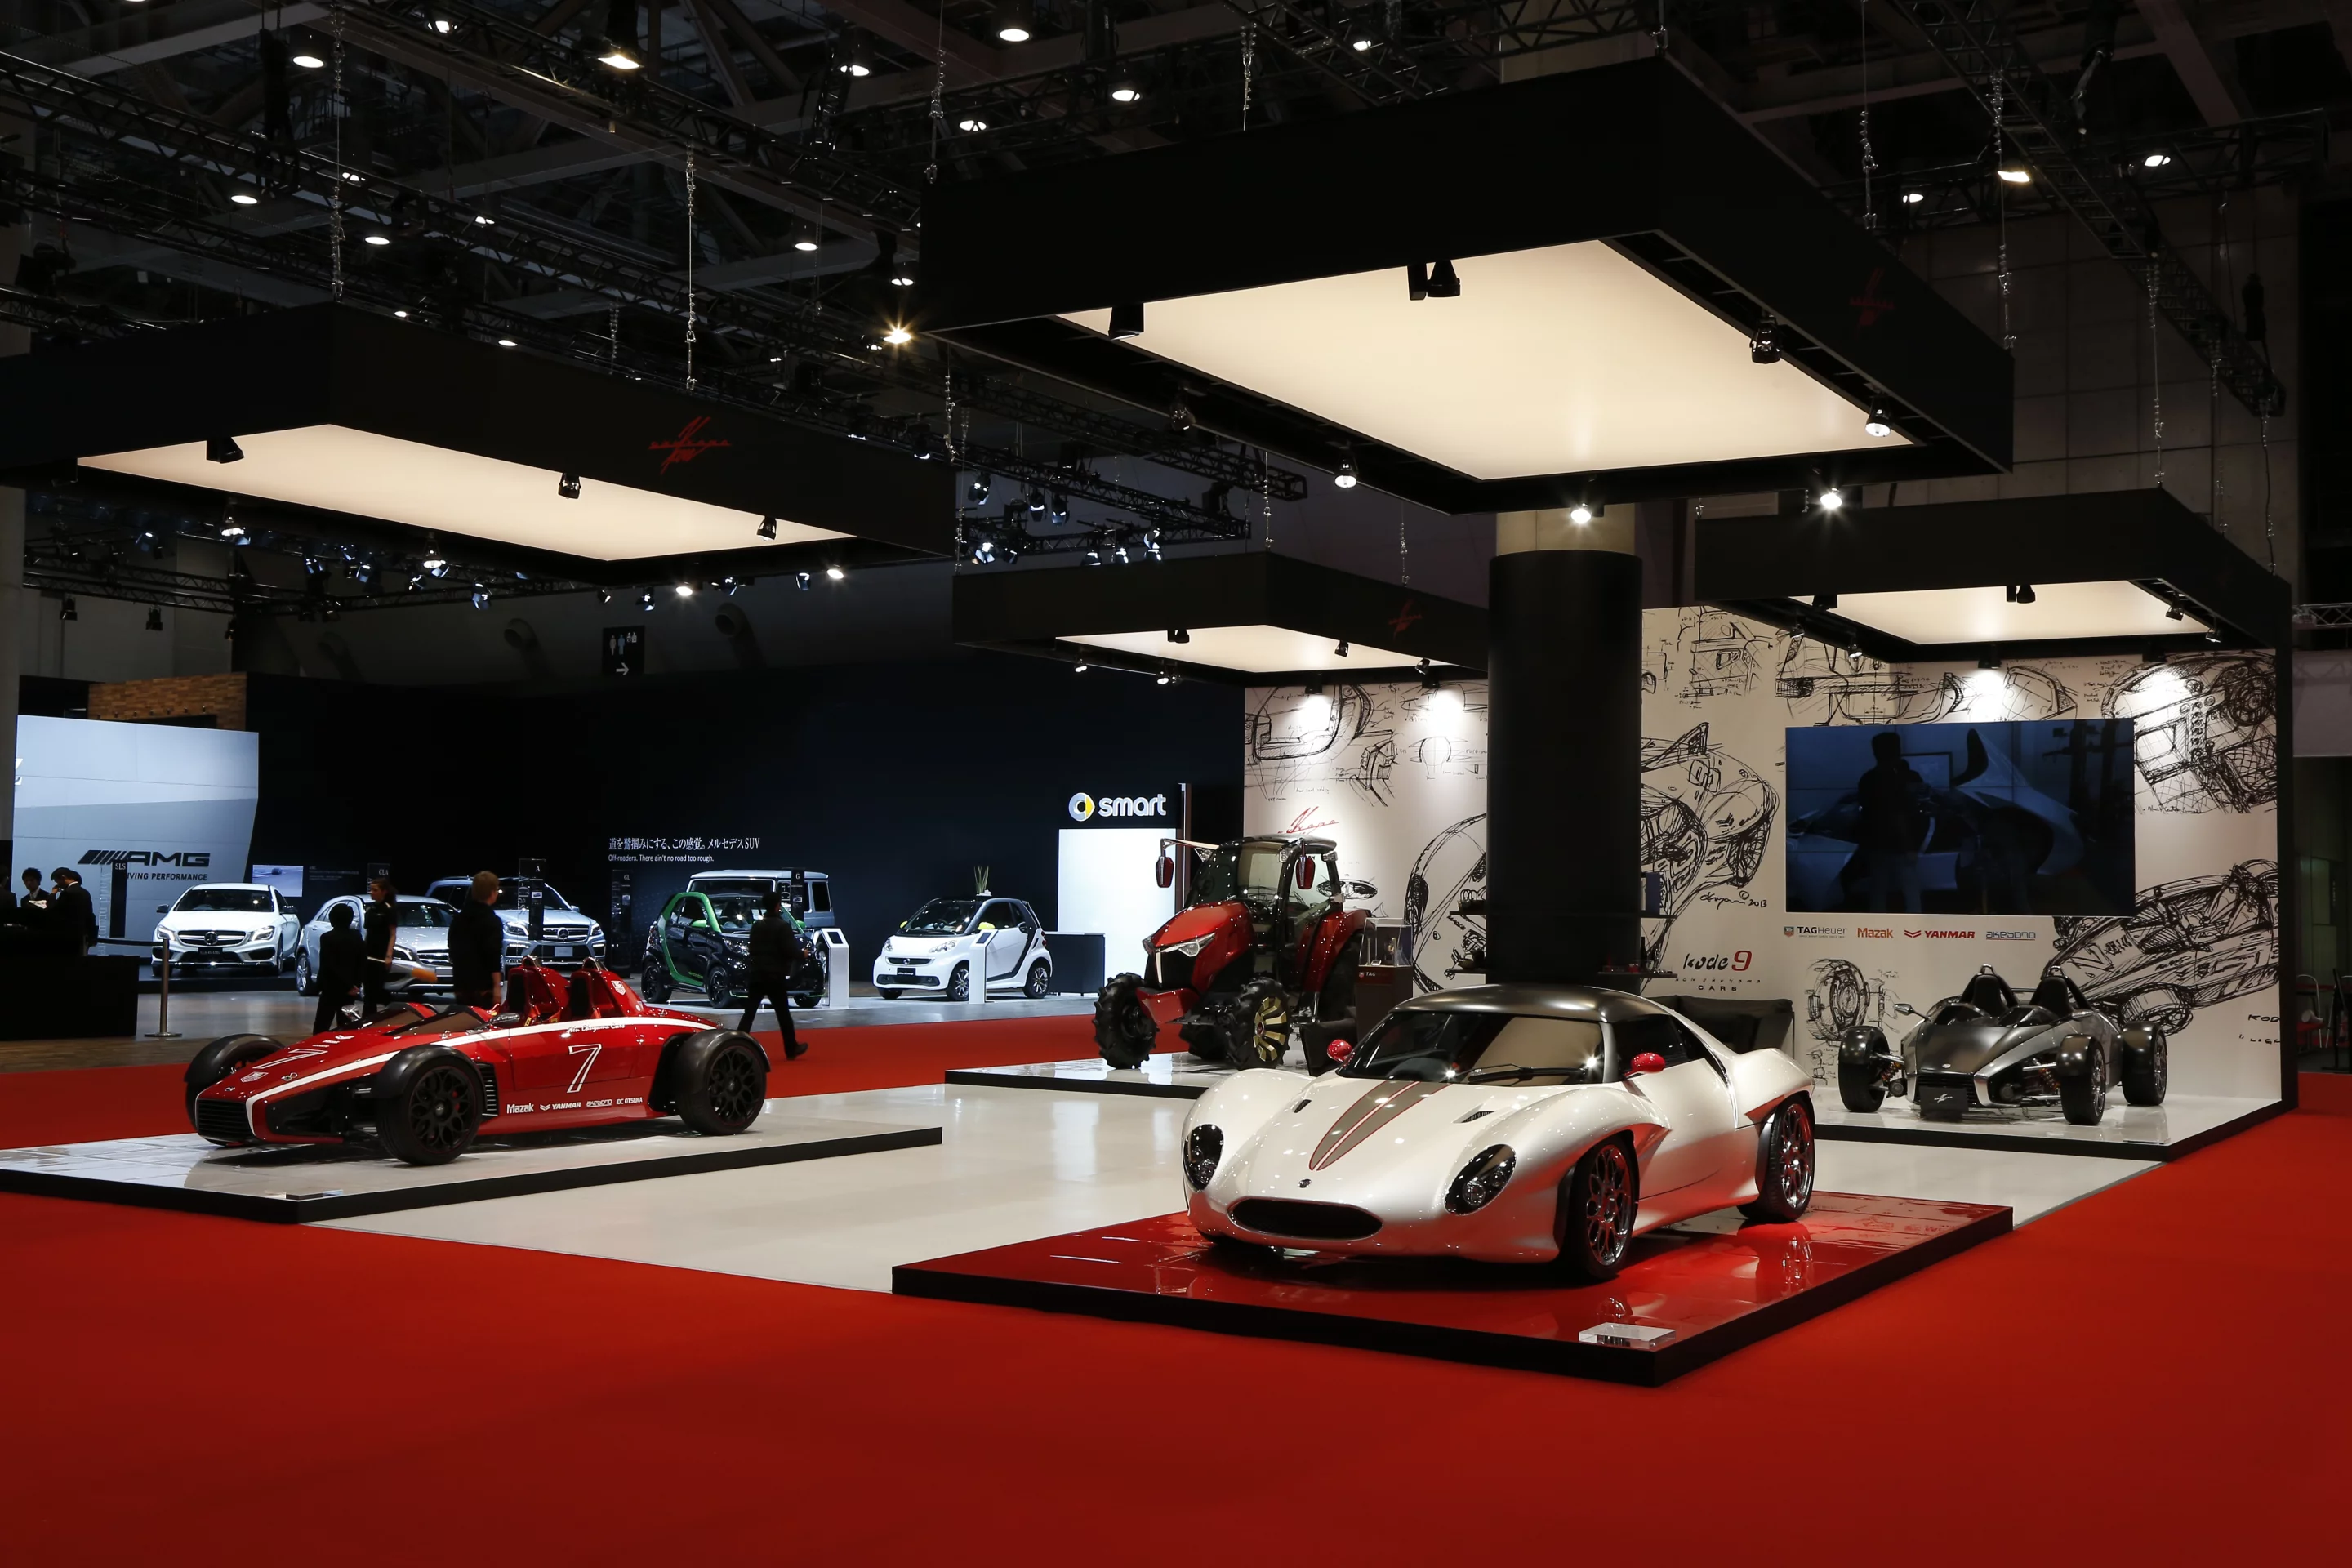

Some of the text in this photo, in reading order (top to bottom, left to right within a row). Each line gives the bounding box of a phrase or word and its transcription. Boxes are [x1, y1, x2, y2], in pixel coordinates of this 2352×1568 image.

[1098, 793, 1167, 817] smart
[123, 850, 211, 867] AMG
[697, 854, 714, 863] rough.
[97, 907, 109, 956] premire
[1857, 927, 1894, 938] Mazak
[1924, 930, 1976, 938] YANMAR
[1731, 950, 1753, 972] 9
[252, 1048, 328, 1069] 7
[566, 1043, 602, 1094] 7
[506, 1102, 535, 1114] Mazak
[552, 1102, 581, 1110] YANMAR
